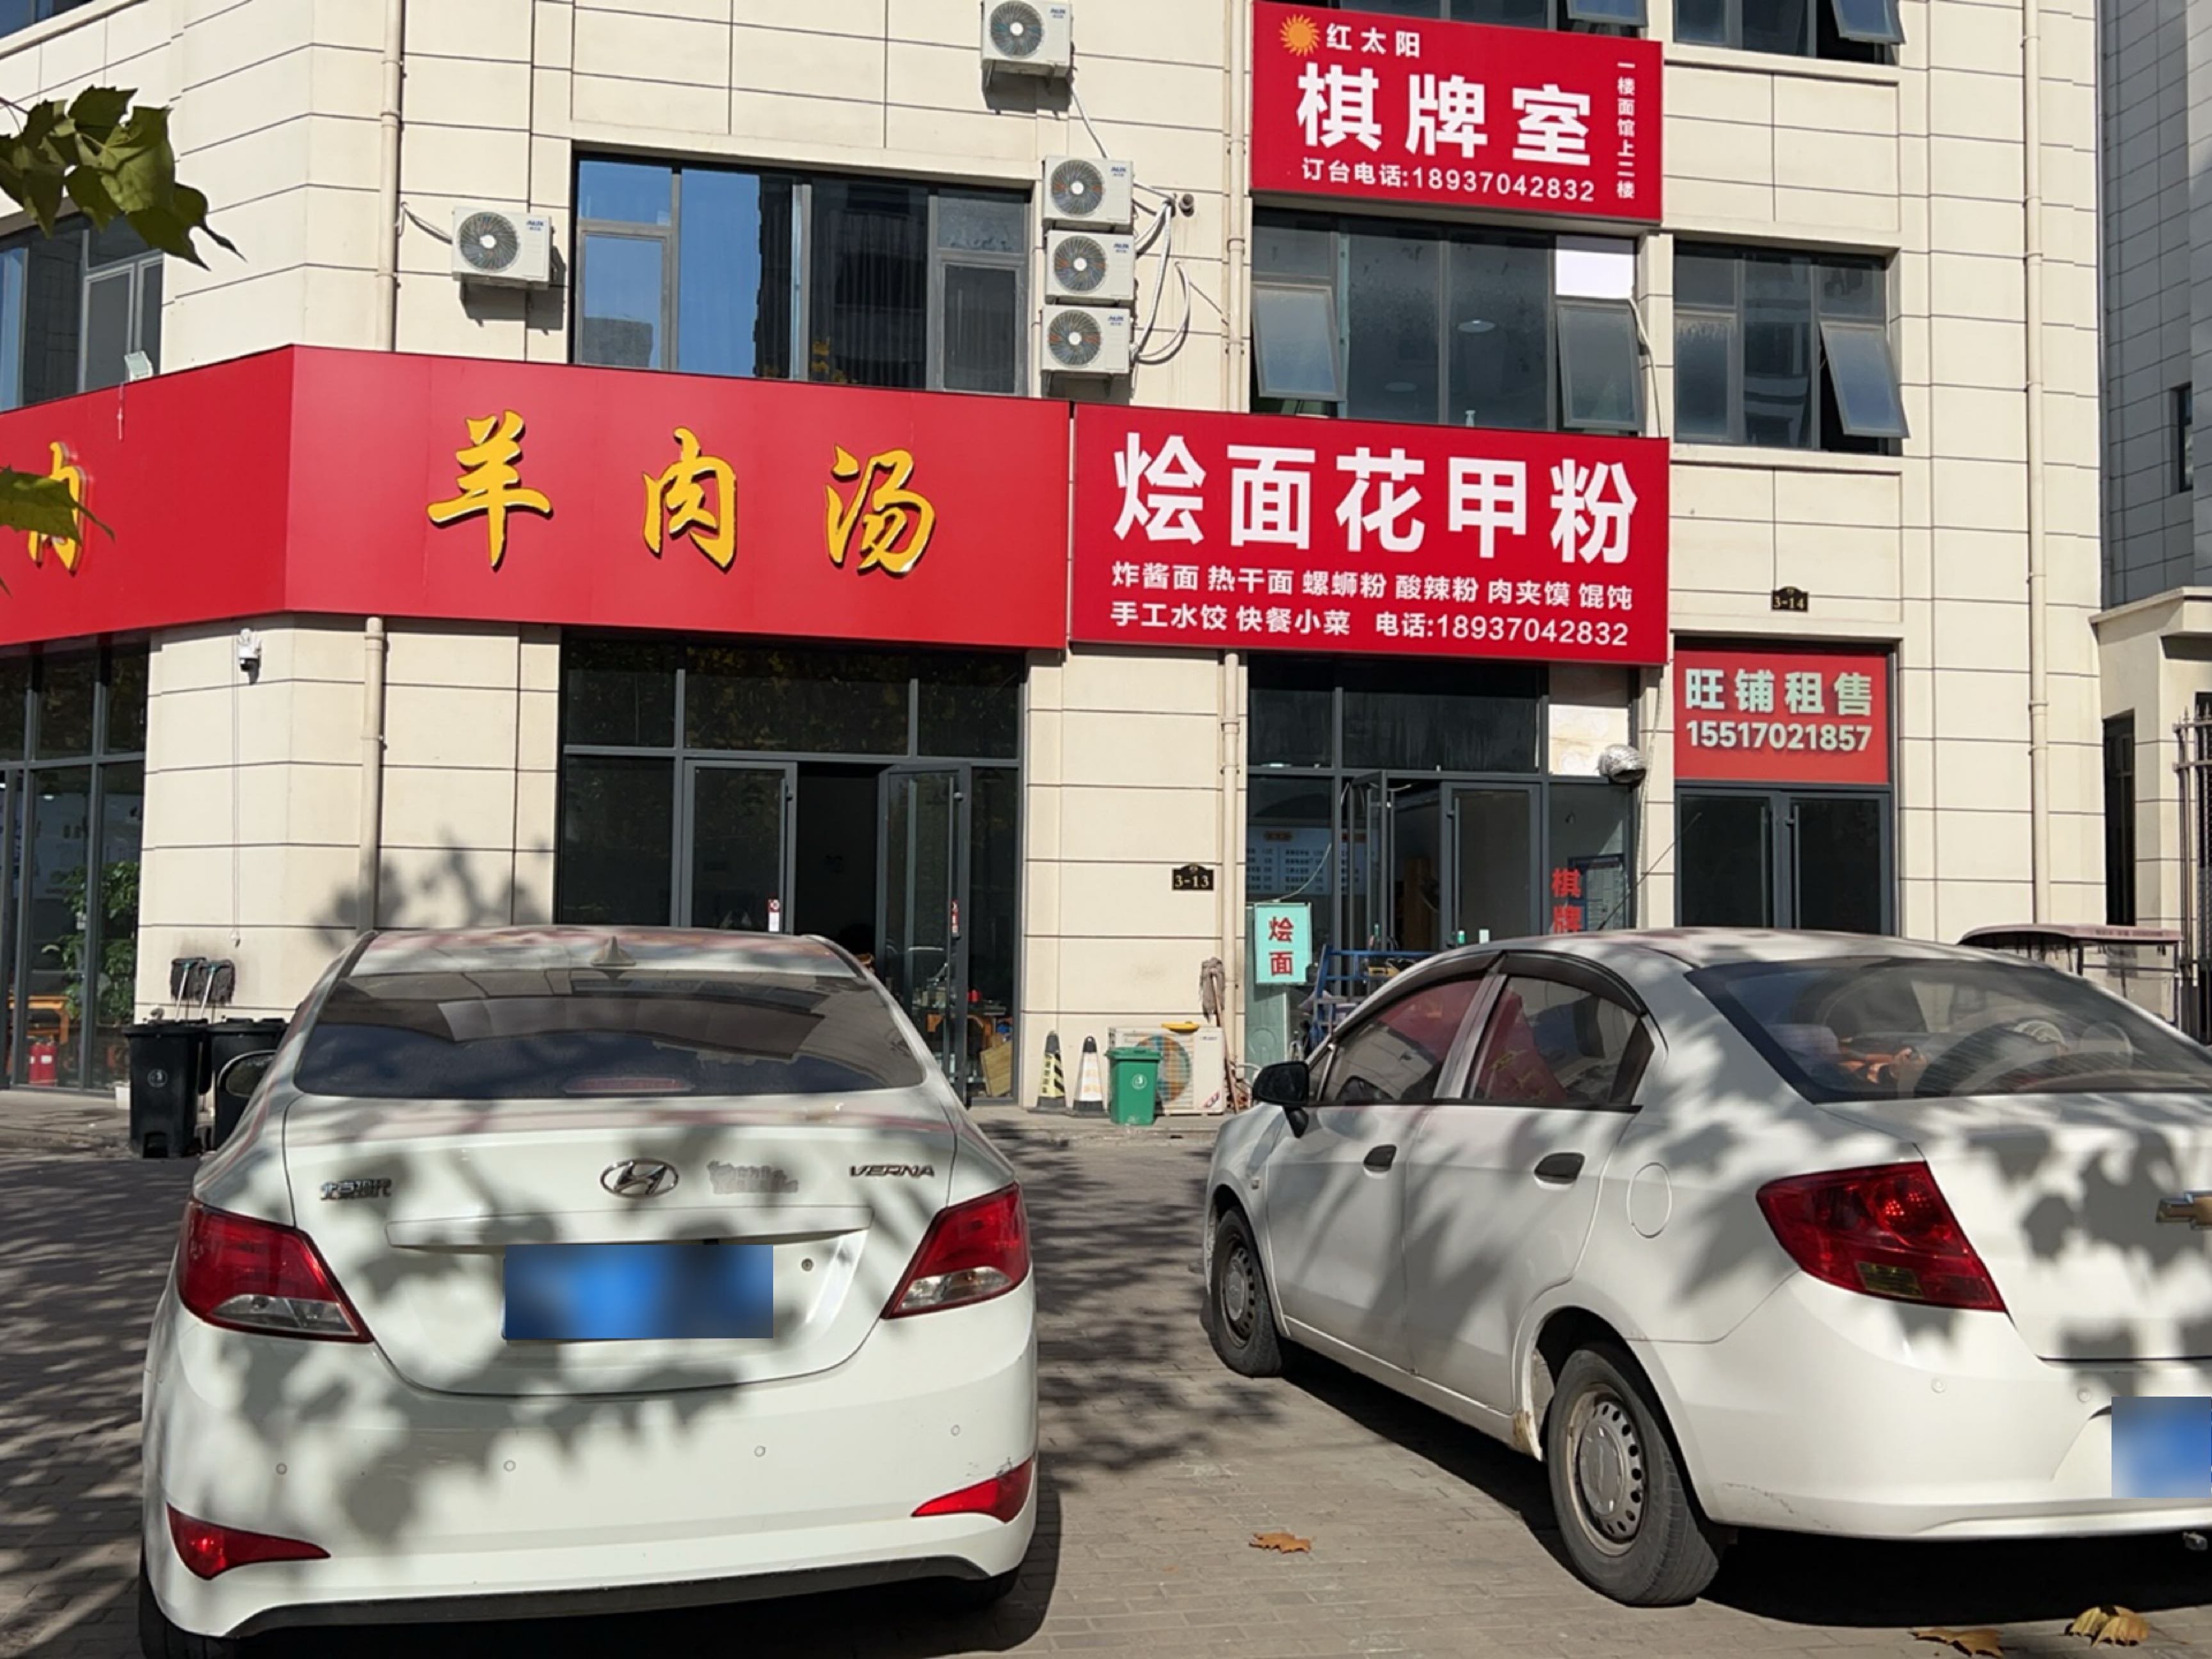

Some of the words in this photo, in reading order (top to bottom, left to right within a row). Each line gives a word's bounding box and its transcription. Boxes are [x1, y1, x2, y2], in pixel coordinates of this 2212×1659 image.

[1326, 23, 1420, 58] 红太阳
[1297, 62, 1591, 166] 棋牌室
[1617, 62, 1636, 199] 一楼面馆上二楼
[1302, 157, 1595, 202] 订台电话:18937042832
[428, 410, 936, 574] 羊肉汤
[1114, 431, 1637, 565] 烩面花甲粉
[1111, 561, 1199, 591] 炸酱面
[1207, 565, 1294, 595] 热干面
[1302, 569, 1387, 599] 螺蛳粉
[1395, 574, 1479, 602] 酸辣粉
[1487, 578, 1571, 606] 肉夹馍
[1578, 583, 1633, 611] 馄饨
[1772, 595, 1805, 609] 3-14
[1110, 600, 1228, 631] 手工水饺
[1235, 605, 1350, 636] 快餐小菜
[1375, 611, 1628, 646] 电话:18937042832
[1685, 668, 1872, 716] 旺铺租售
[1686, 720, 1872, 751] 15517021857
[1174, 874, 1210, 888] 3-13
[1551, 867, 1582, 933] 棋牌
[1268, 916, 1294, 977] 烩面
[849, 1164, 935, 1178] VERNA
